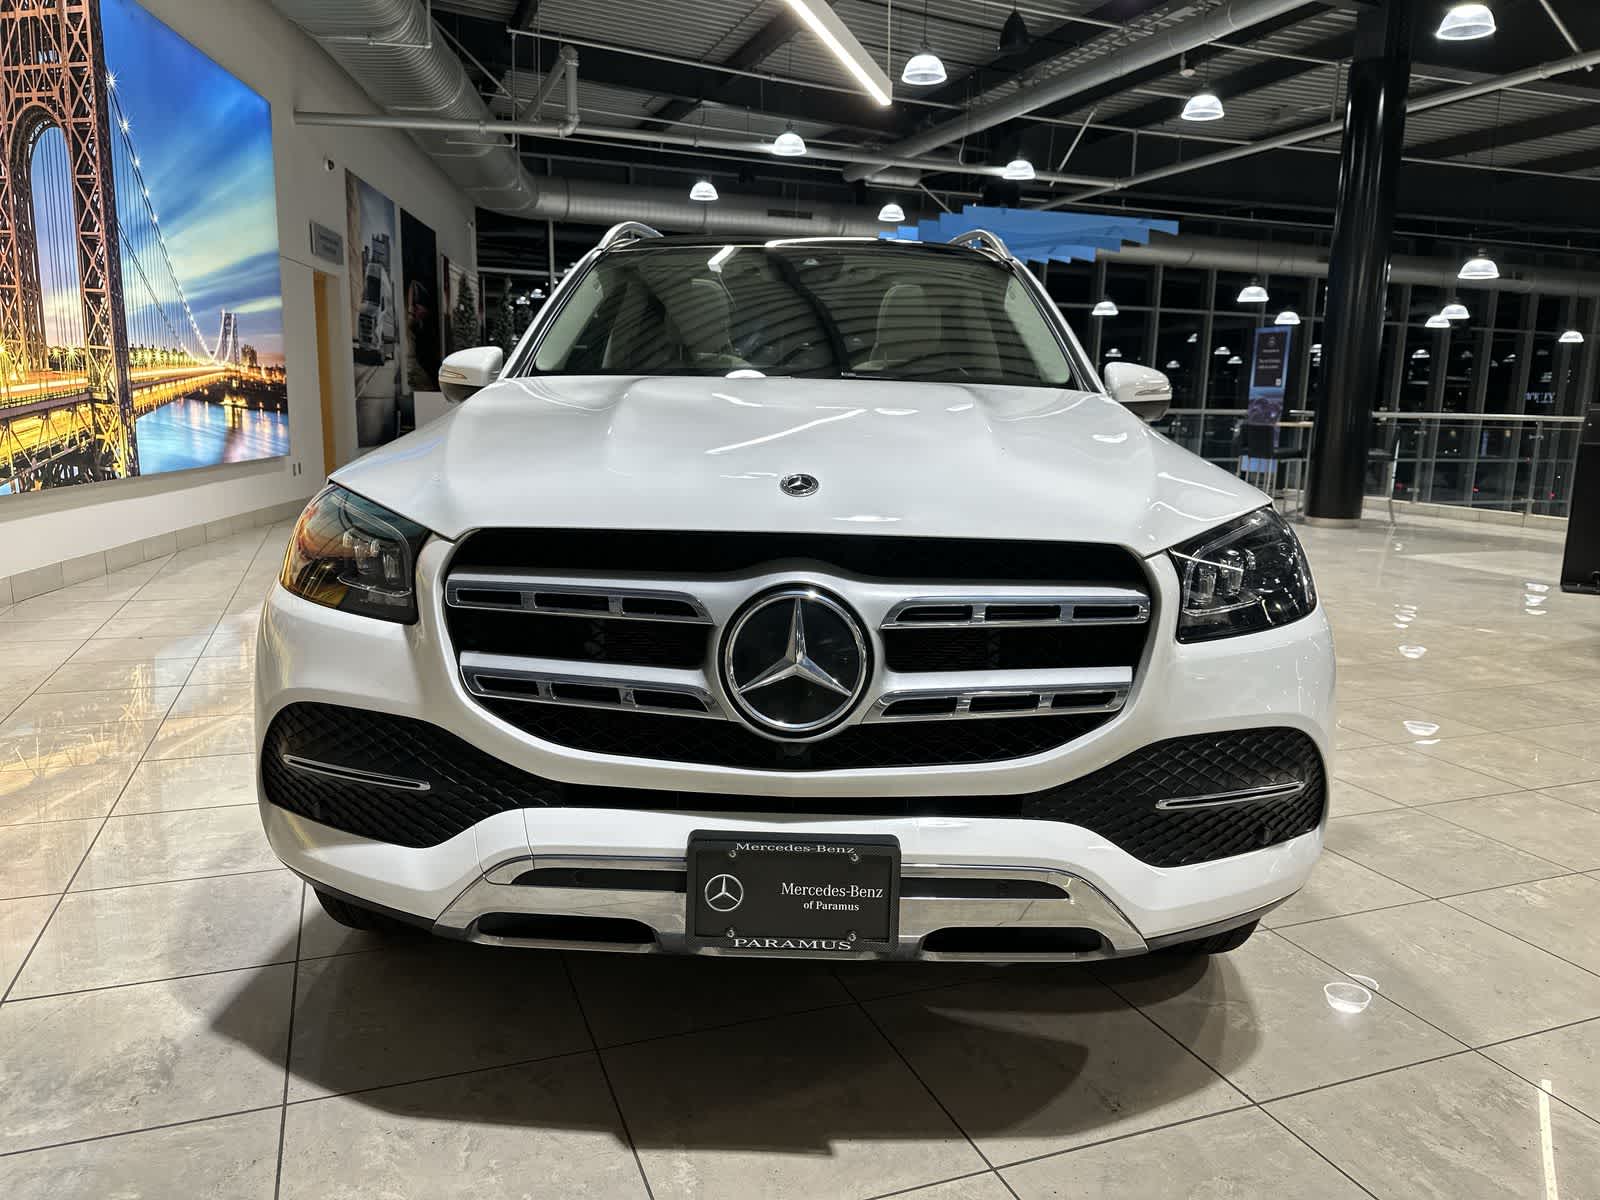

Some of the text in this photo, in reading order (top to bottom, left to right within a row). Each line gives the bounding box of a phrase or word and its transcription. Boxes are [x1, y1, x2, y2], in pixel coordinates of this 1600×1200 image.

[735, 842, 855, 855] Mercedes-Benz
[781, 882, 884, 899] Mercedes-Benz
[803, 900, 860, 912] of Paramus
[733, 938, 852, 951] PARAMUS
